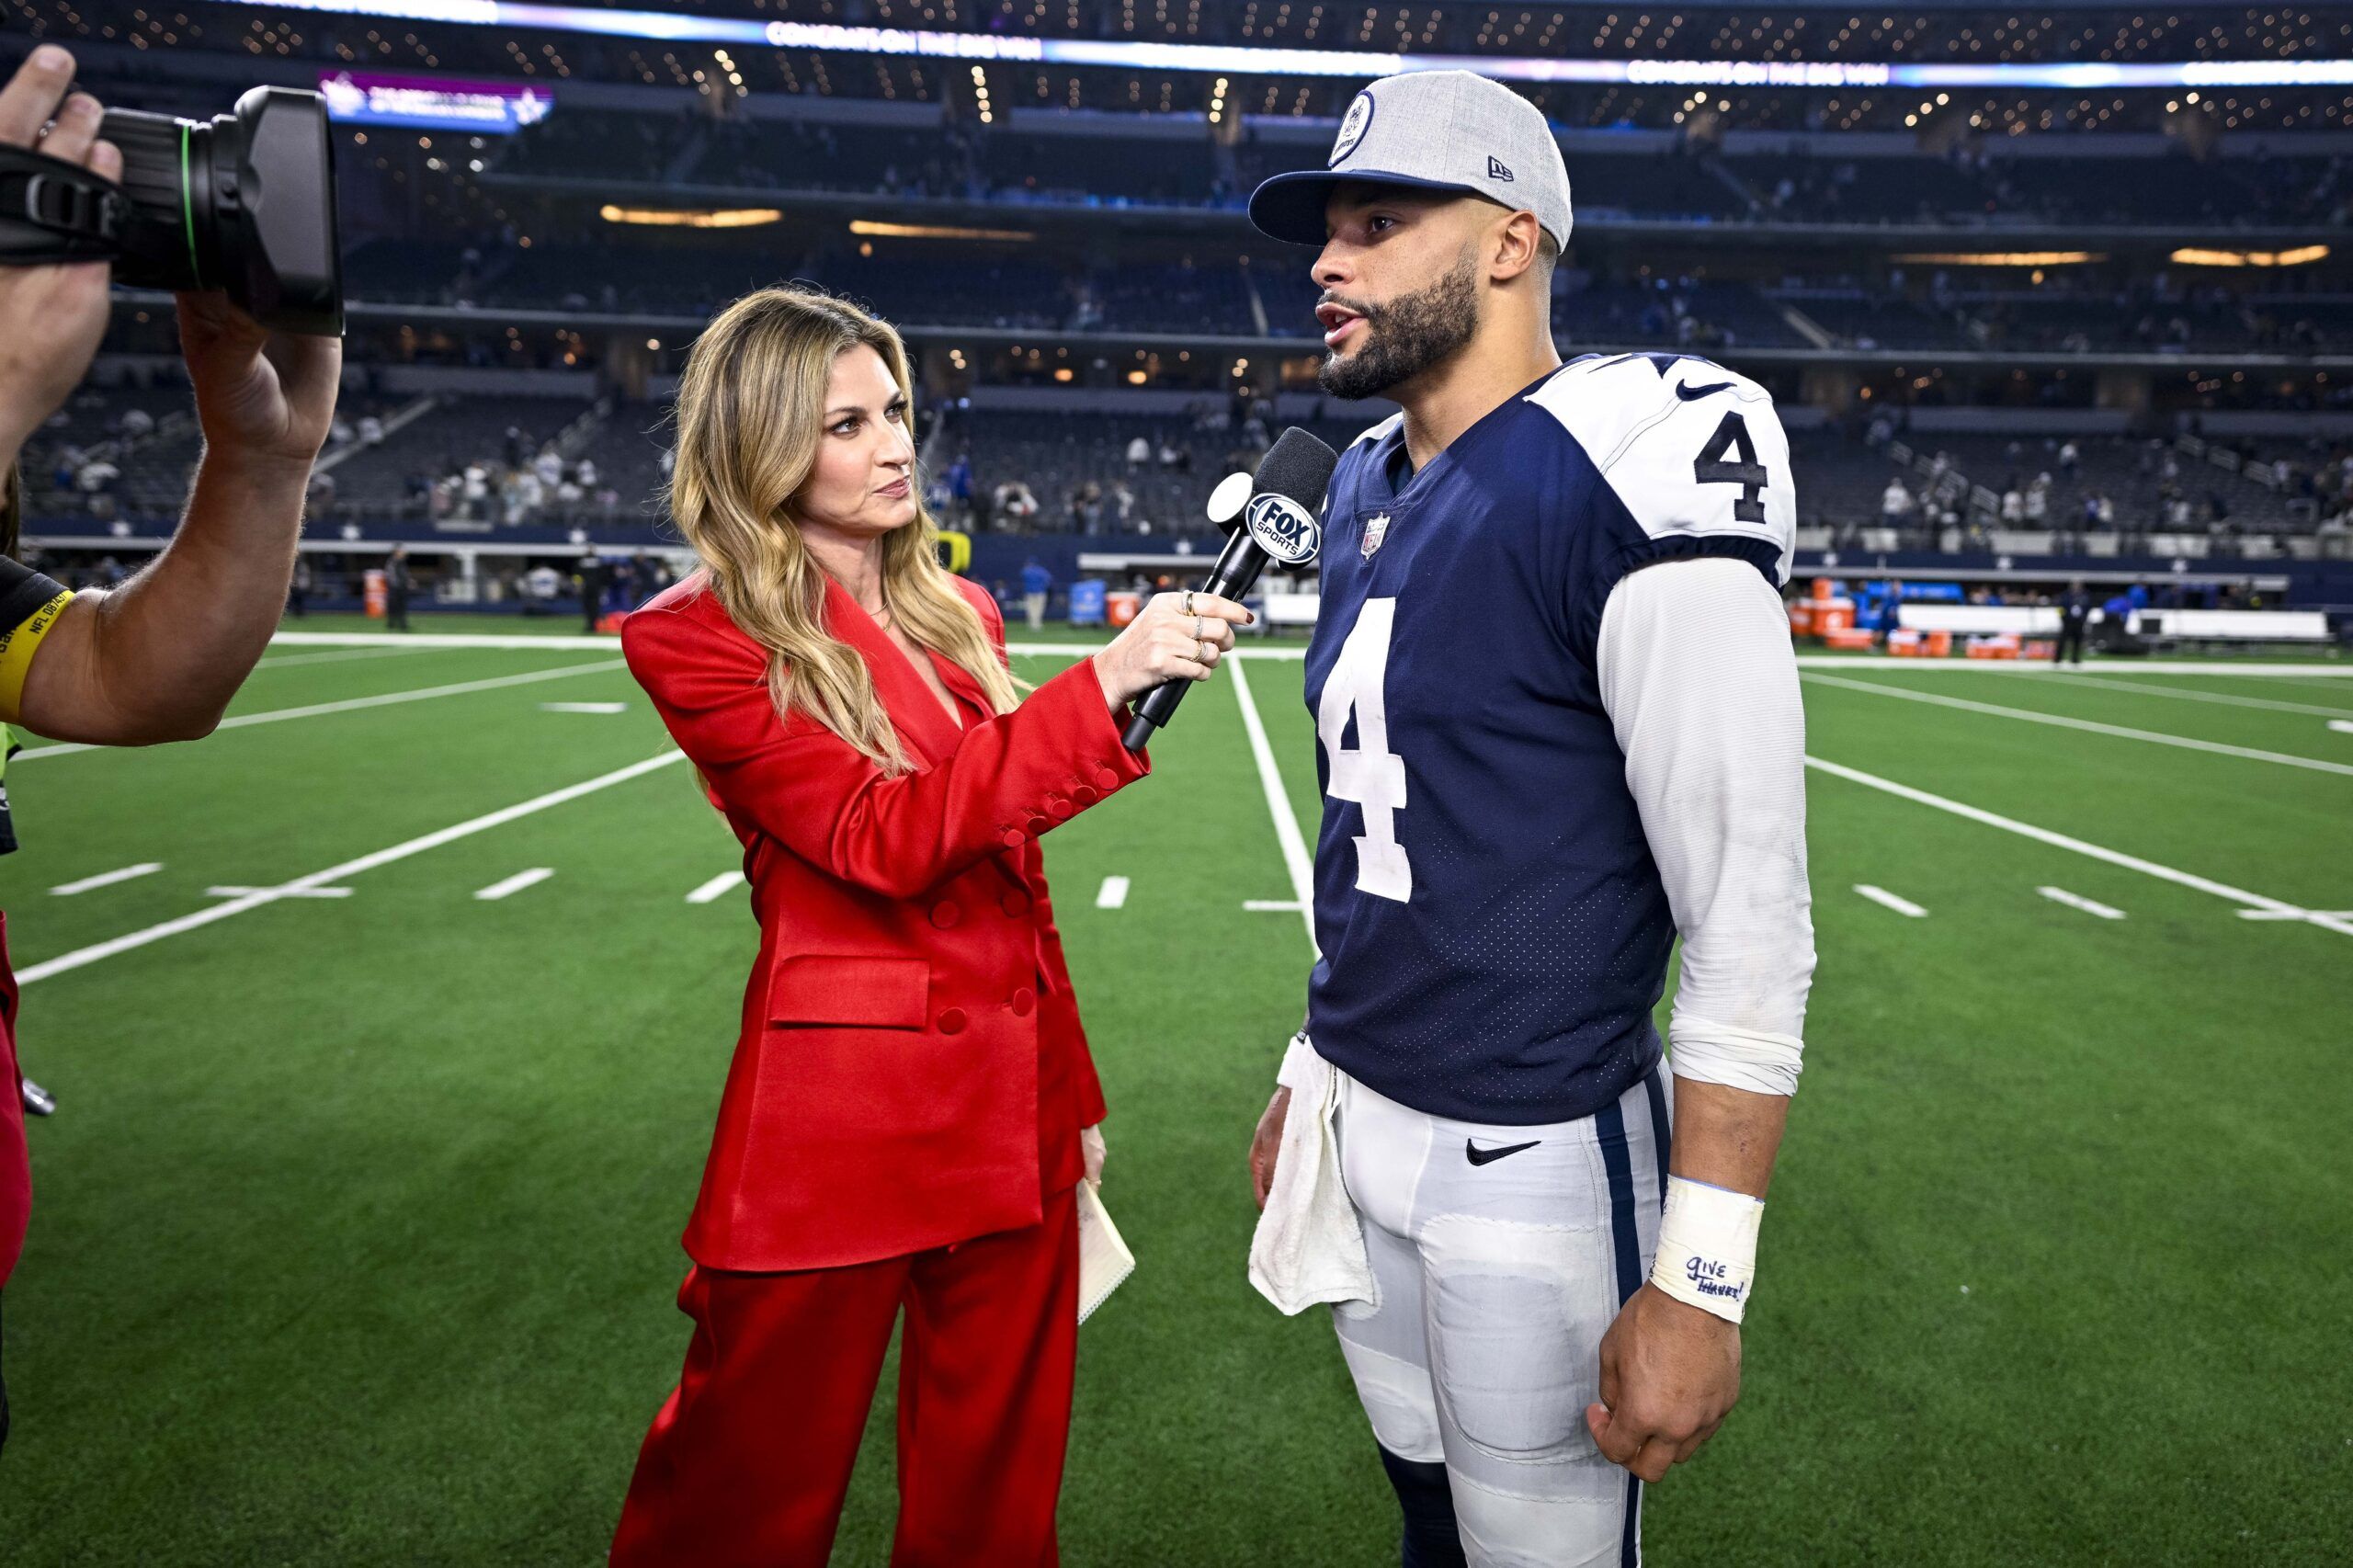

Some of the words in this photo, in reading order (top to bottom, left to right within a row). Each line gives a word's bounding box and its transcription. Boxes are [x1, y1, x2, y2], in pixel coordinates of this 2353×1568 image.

[1694, 410, 1768, 525] 4
[1256, 521, 1299, 556] SPORTS
[1261, 501, 1311, 548] FOX
[29, 617, 50, 634] NFL
[1318, 597, 1413, 903] 4
